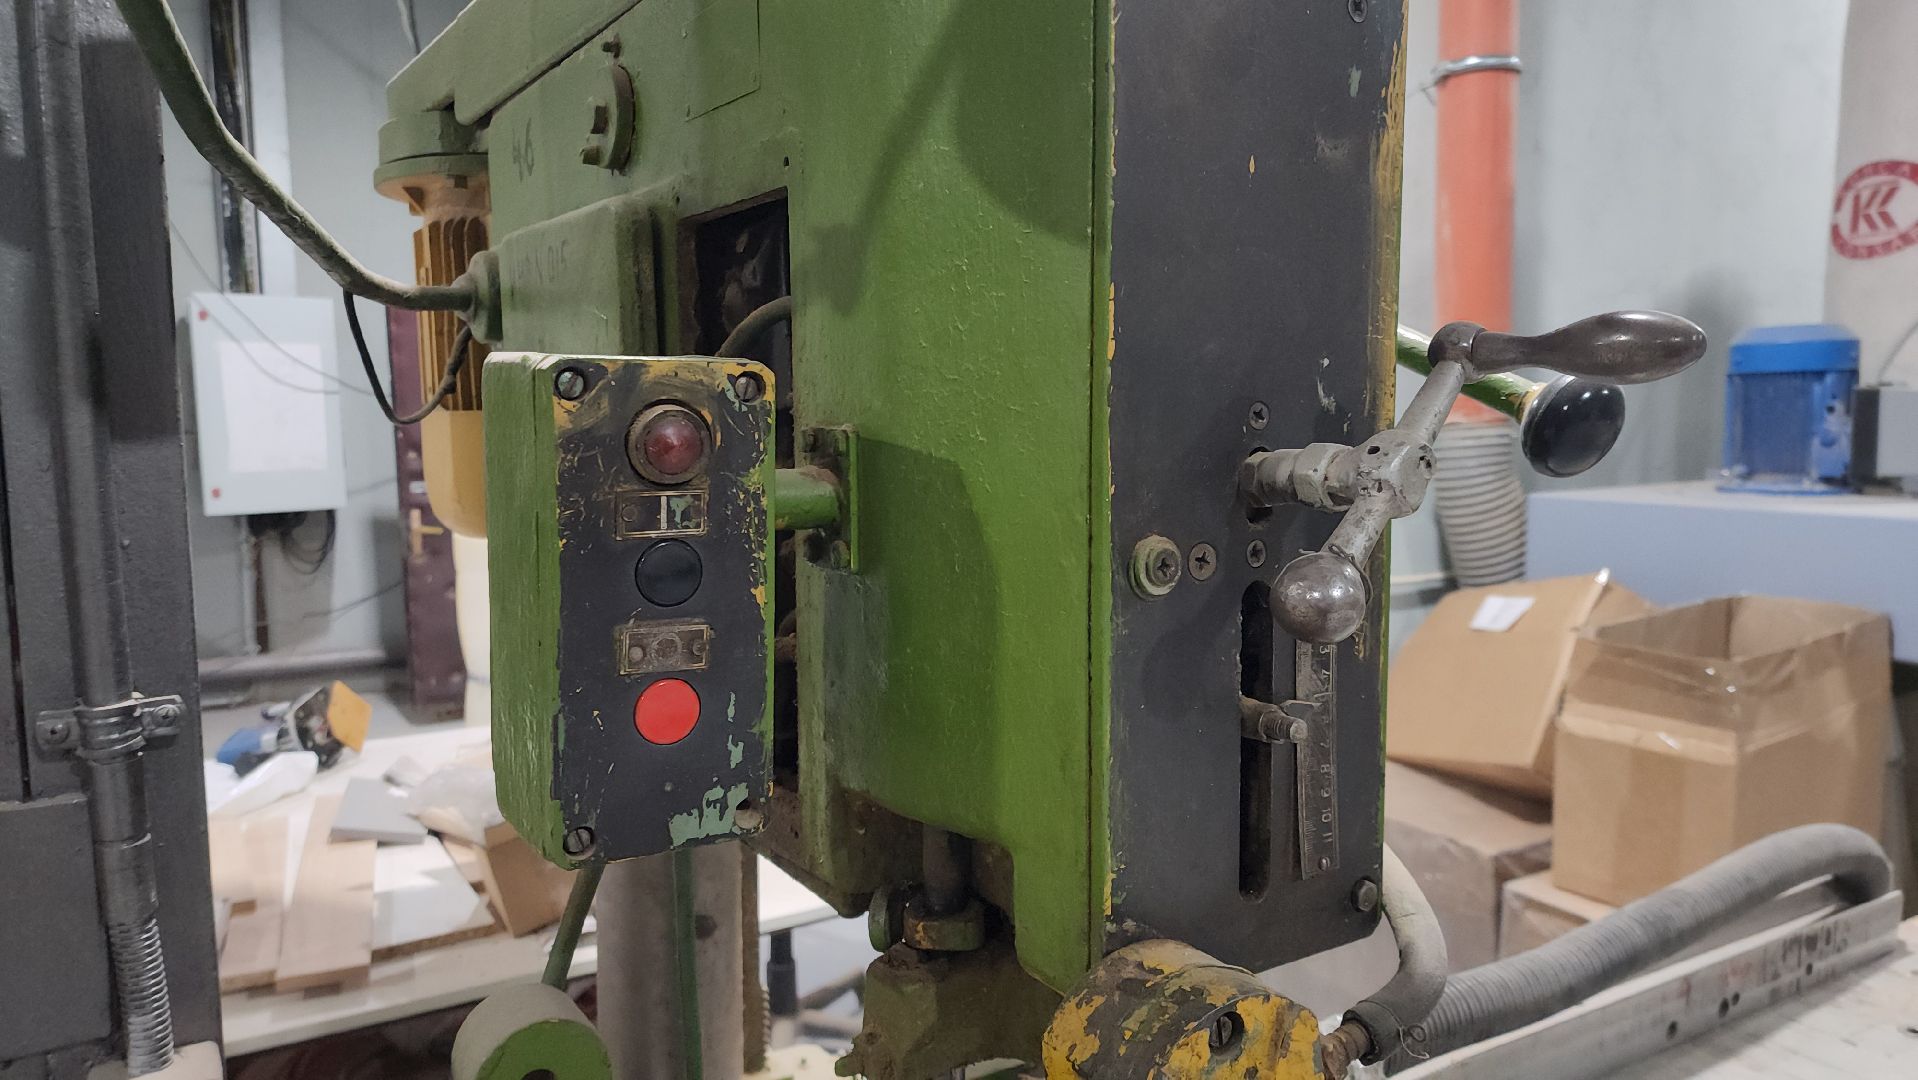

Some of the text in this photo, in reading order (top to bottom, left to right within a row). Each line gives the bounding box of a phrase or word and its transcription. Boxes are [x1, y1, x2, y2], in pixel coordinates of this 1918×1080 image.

[1320, 763, 1331, 774] 8
[1320, 786, 1331, 798] 9
[1321, 808, 1332, 823] 10
